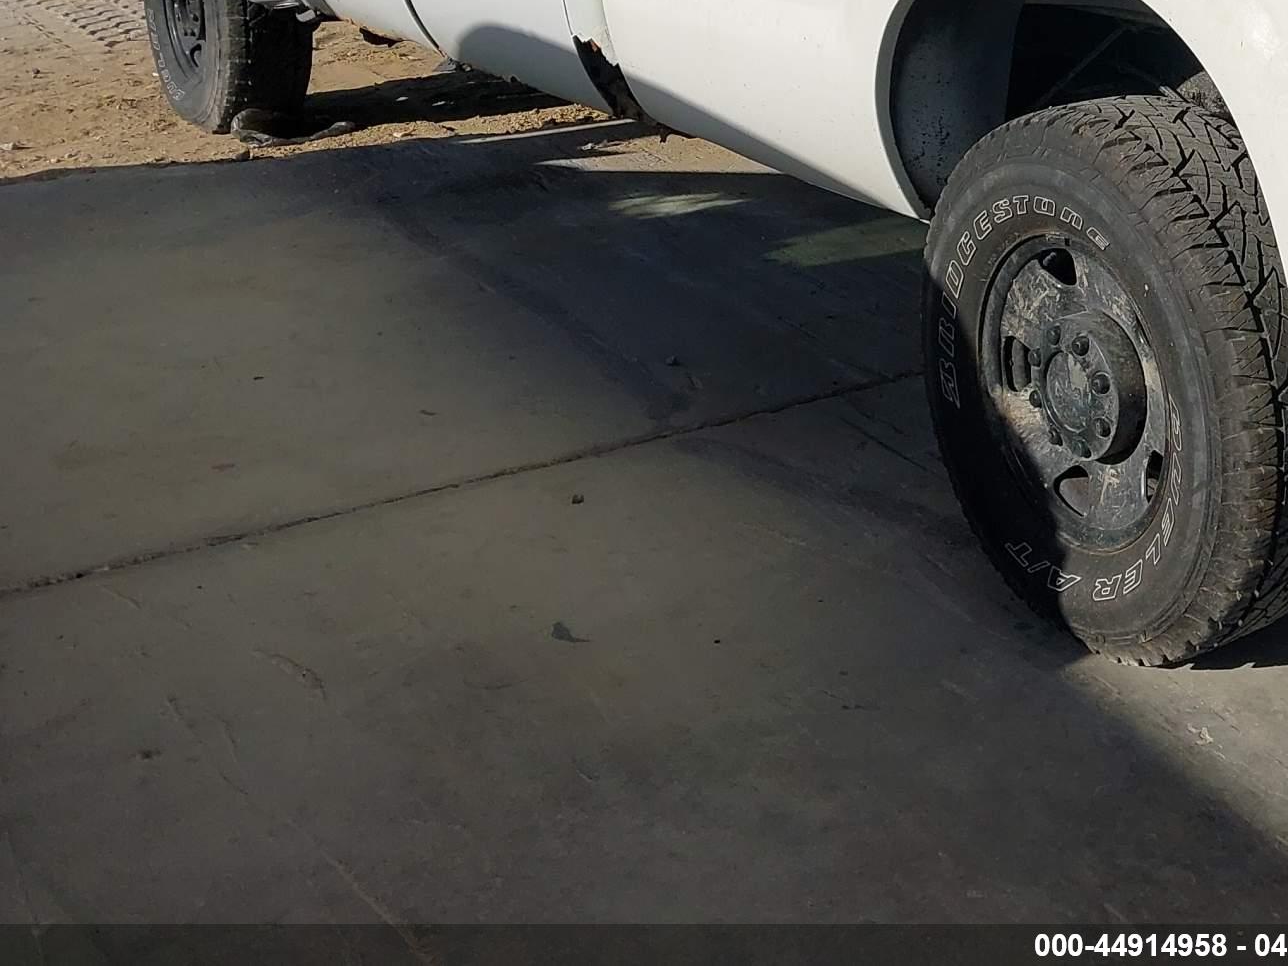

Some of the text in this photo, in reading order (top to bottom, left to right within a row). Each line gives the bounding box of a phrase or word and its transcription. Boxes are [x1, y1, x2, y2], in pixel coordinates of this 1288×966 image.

[938, 195, 1110, 410] BRIDGESTONE
[1004, 394, 1183, 602] DUELER A/T
